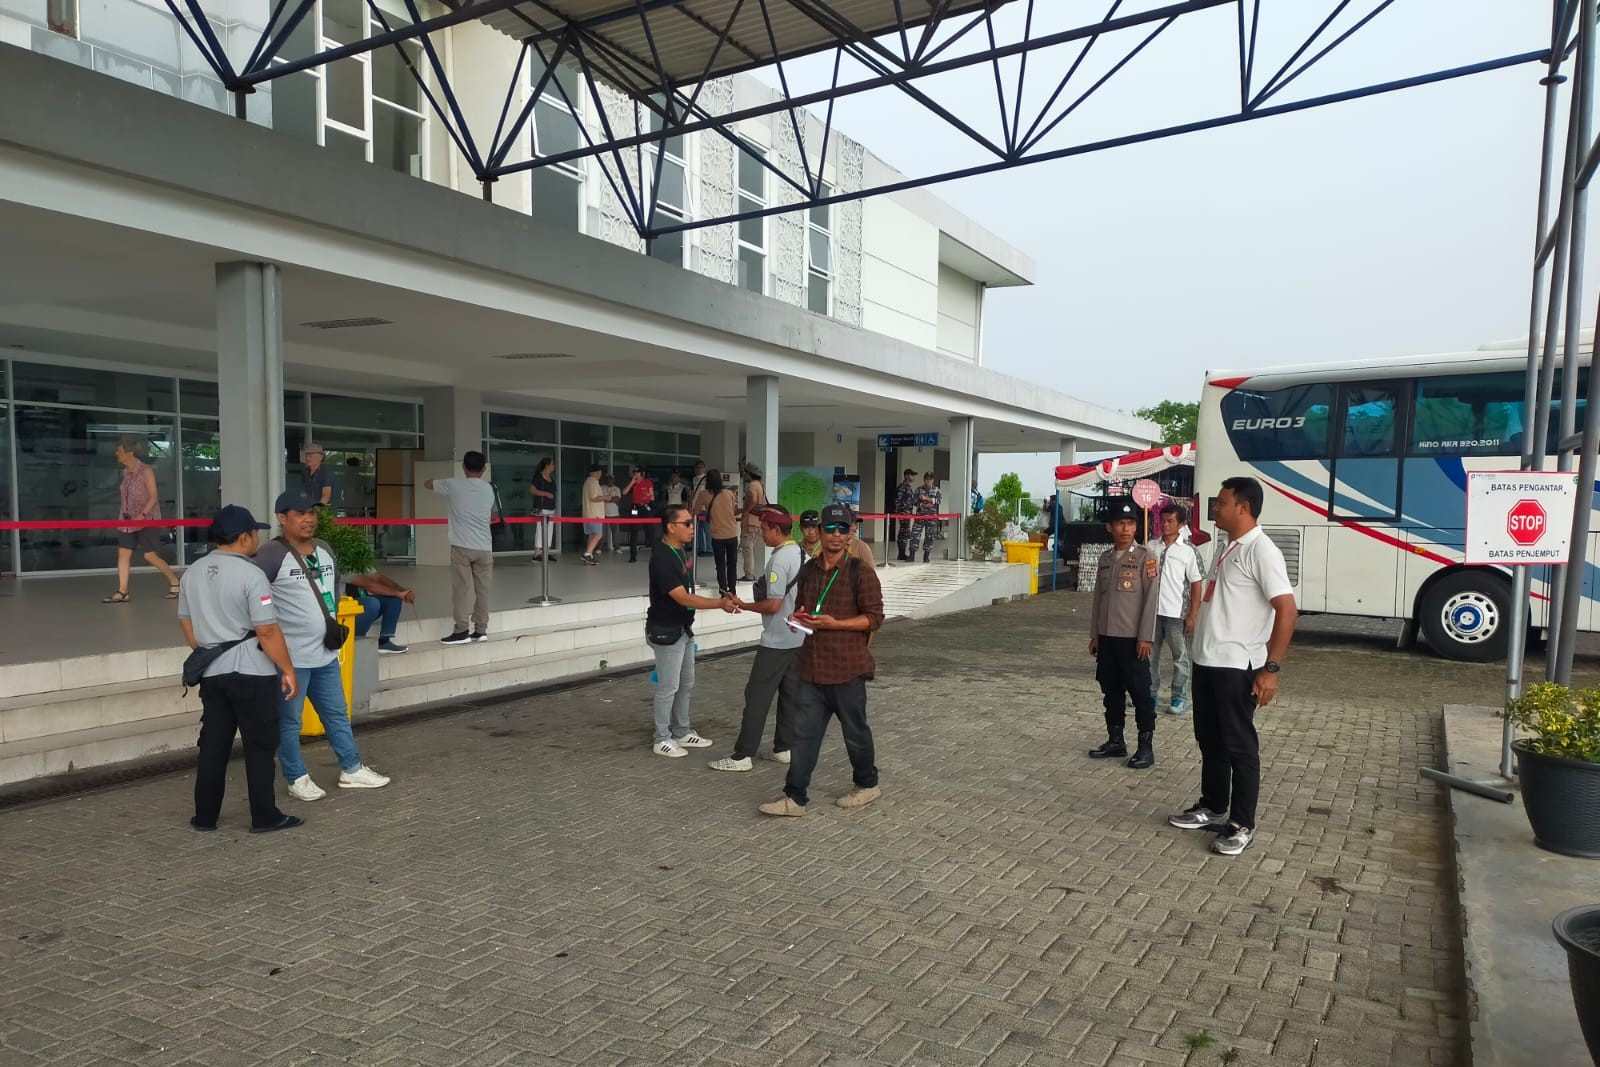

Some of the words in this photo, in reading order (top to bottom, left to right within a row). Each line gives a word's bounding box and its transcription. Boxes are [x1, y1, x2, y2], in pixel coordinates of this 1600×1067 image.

[1518, 484, 1563, 492] PENGANTAR
[1510, 515, 1543, 531] STOP
[1516, 550, 1560, 558] PENJEMPUT
